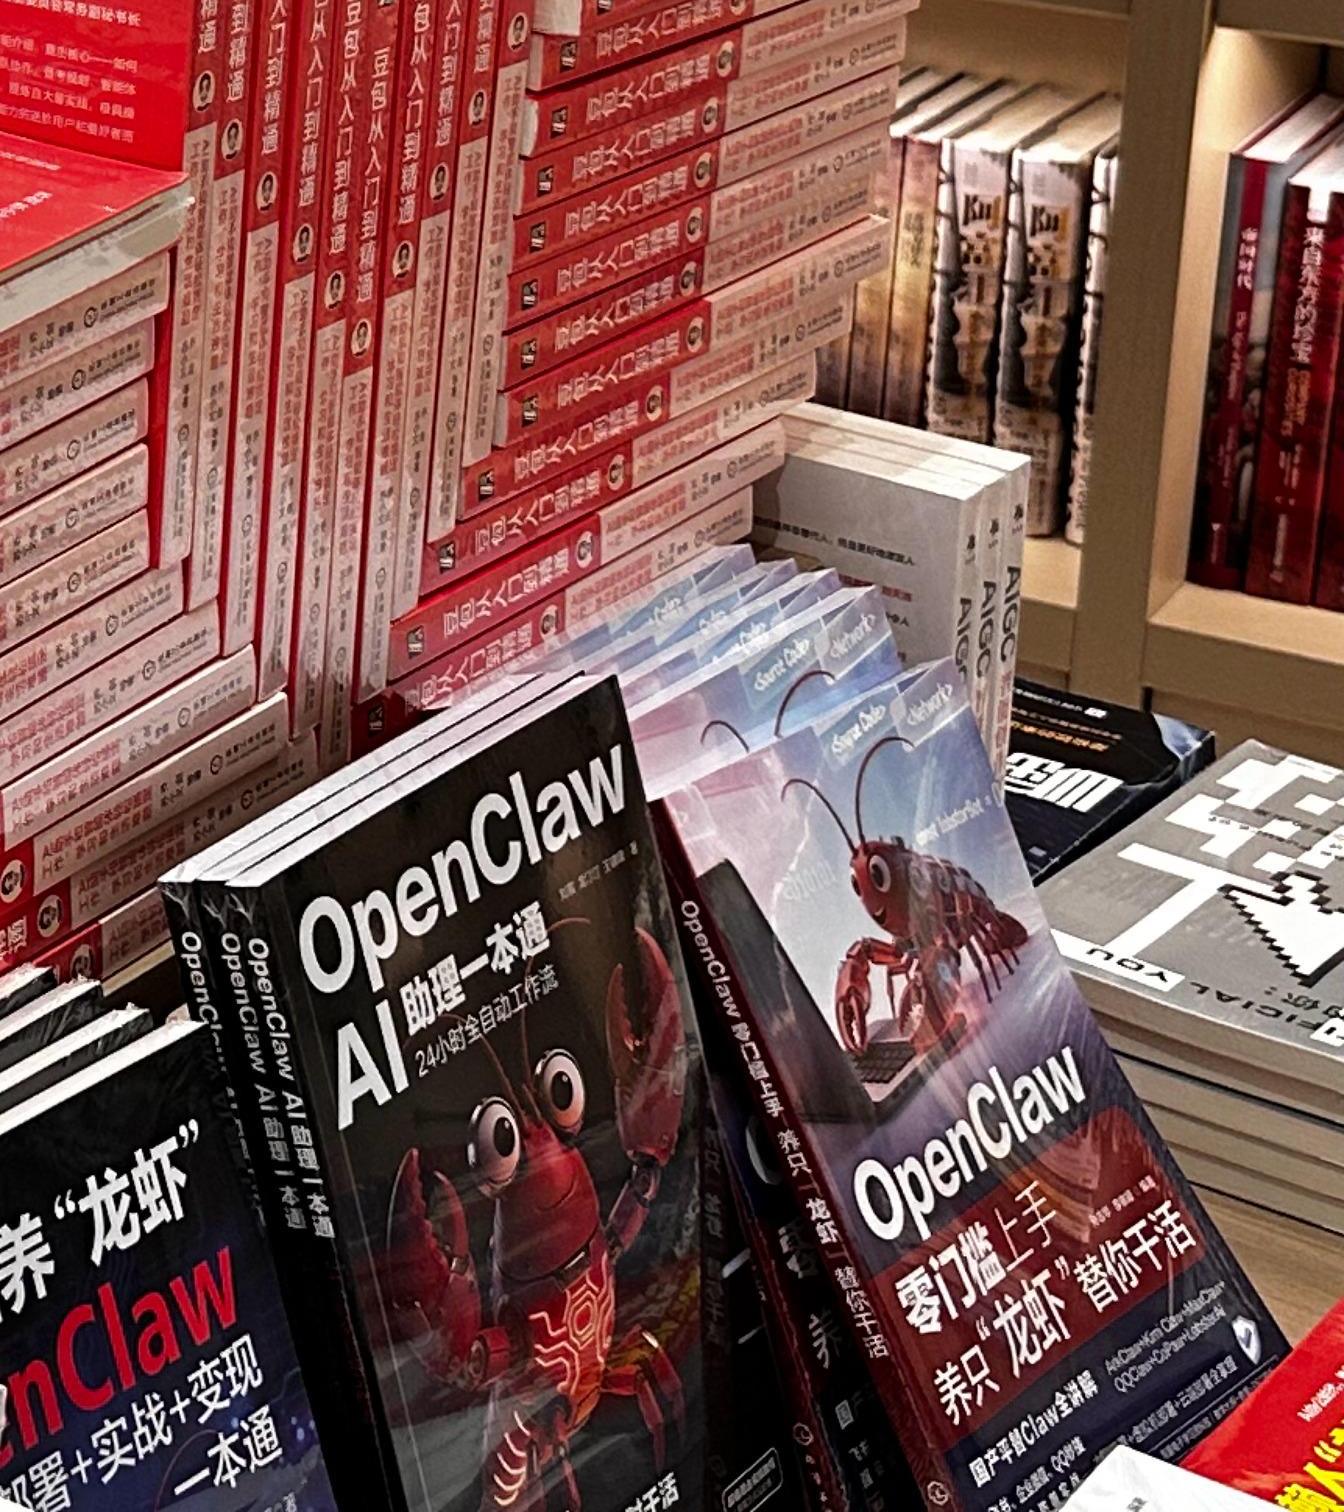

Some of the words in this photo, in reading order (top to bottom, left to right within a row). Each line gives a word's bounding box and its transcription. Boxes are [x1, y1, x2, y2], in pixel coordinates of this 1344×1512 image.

[358, 46, 391, 304] 豆包从入门到精通
[976, 580, 997, 679] AIGC
[1000, 565, 1022, 664] AIGC
[297, 742, 626, 995] OpenClaw
[220, 932, 267, 1076] OpenClaw
[248, 937, 294, 1083] OpenClaw
[335, 999, 410, 1131] AI
[401, 900, 553, 1038] 助理一本通
[413, 961, 562, 1079] 24小时全自动工作流
[681, 899, 741, 1022] OpenClaw
[1086, 946, 1171, 984] YOU
[854, 1040, 1088, 1243] OpenClaw
[895, 1180, 1058, 1335] 零门槛上手
[933, 1199, 1198, 1426] 养只“龙虾”替你干活
[174, 1405, 284, 1497] 一本通
